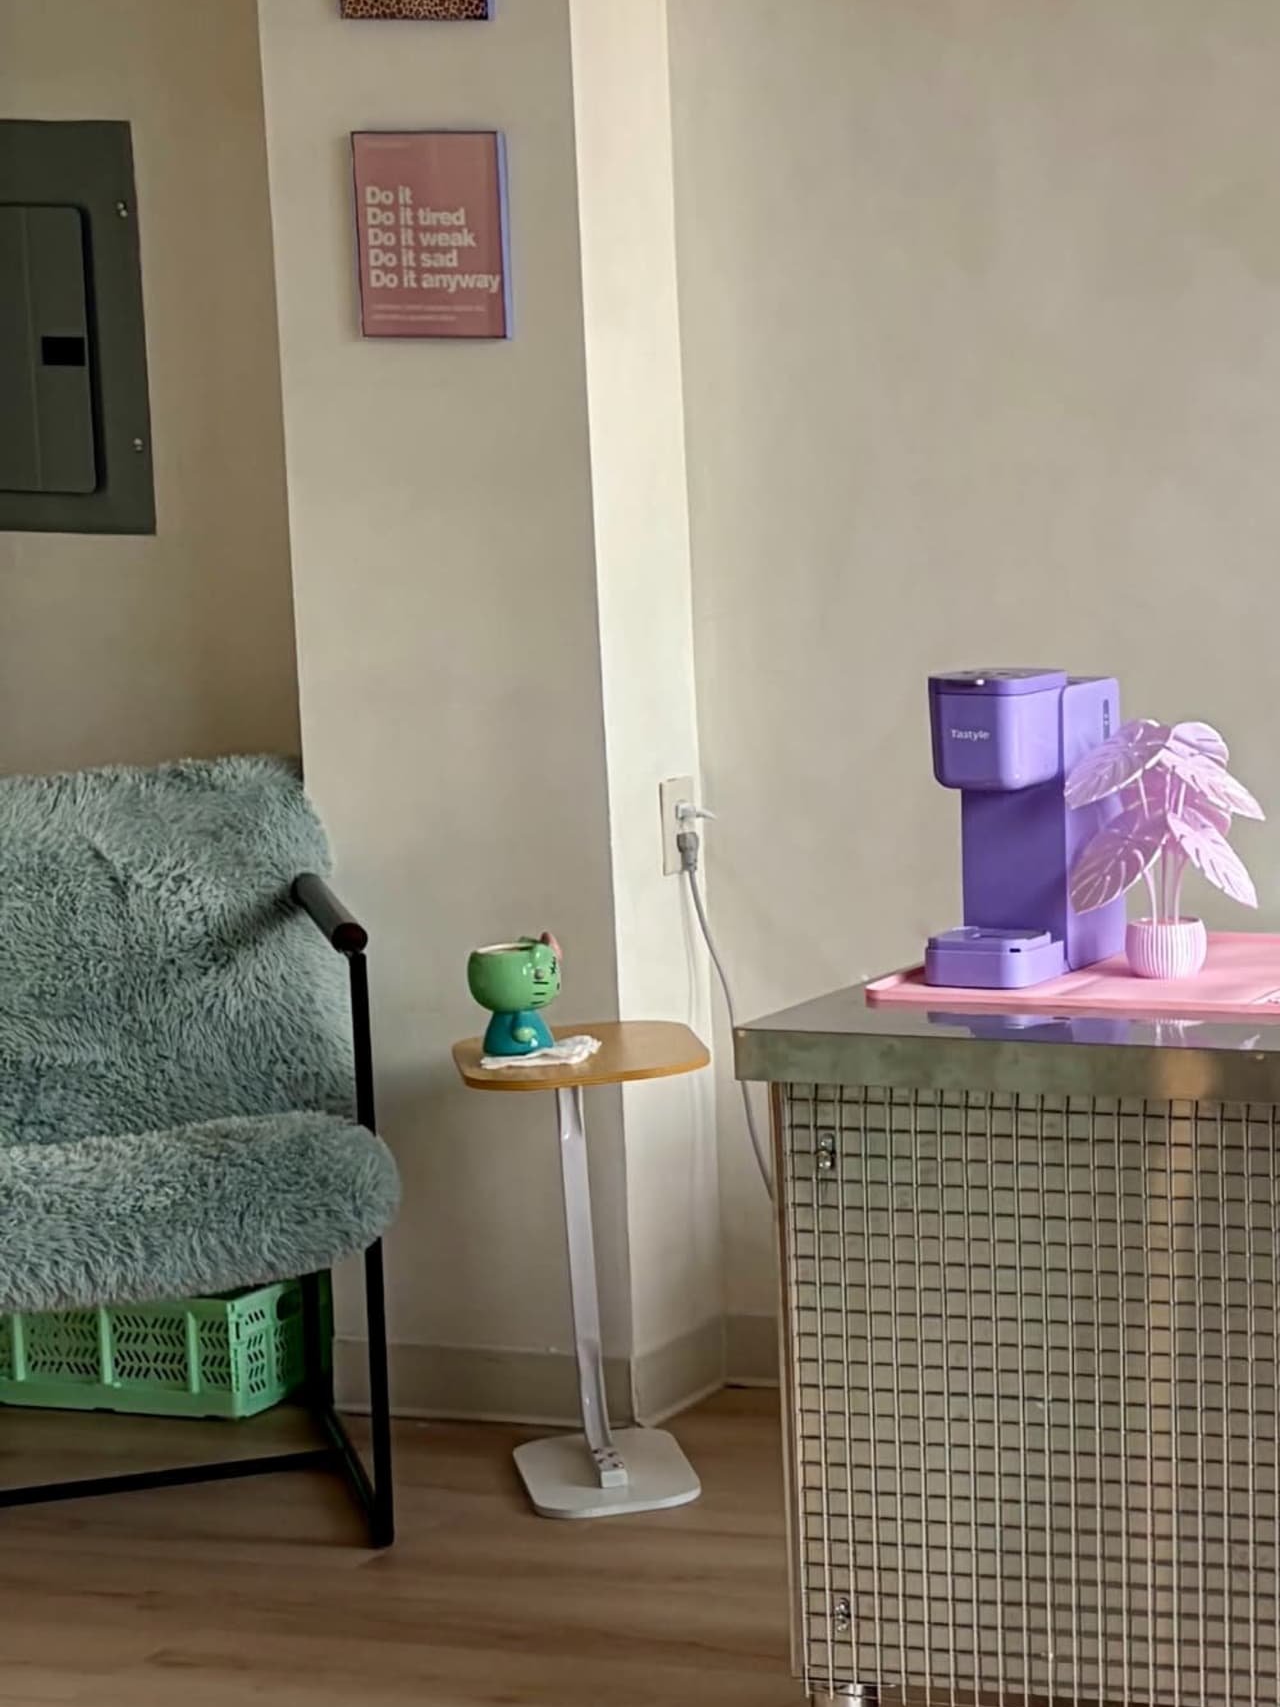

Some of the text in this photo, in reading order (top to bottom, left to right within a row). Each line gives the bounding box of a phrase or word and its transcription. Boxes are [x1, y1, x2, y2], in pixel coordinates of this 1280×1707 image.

[365, 185, 413, 205] Do it
[367, 206, 466, 226] Do it tired
[368, 228, 476, 247] Do it weak
[369, 248, 459, 268] Do it sad
[370, 269, 501, 293] Do it anyway
